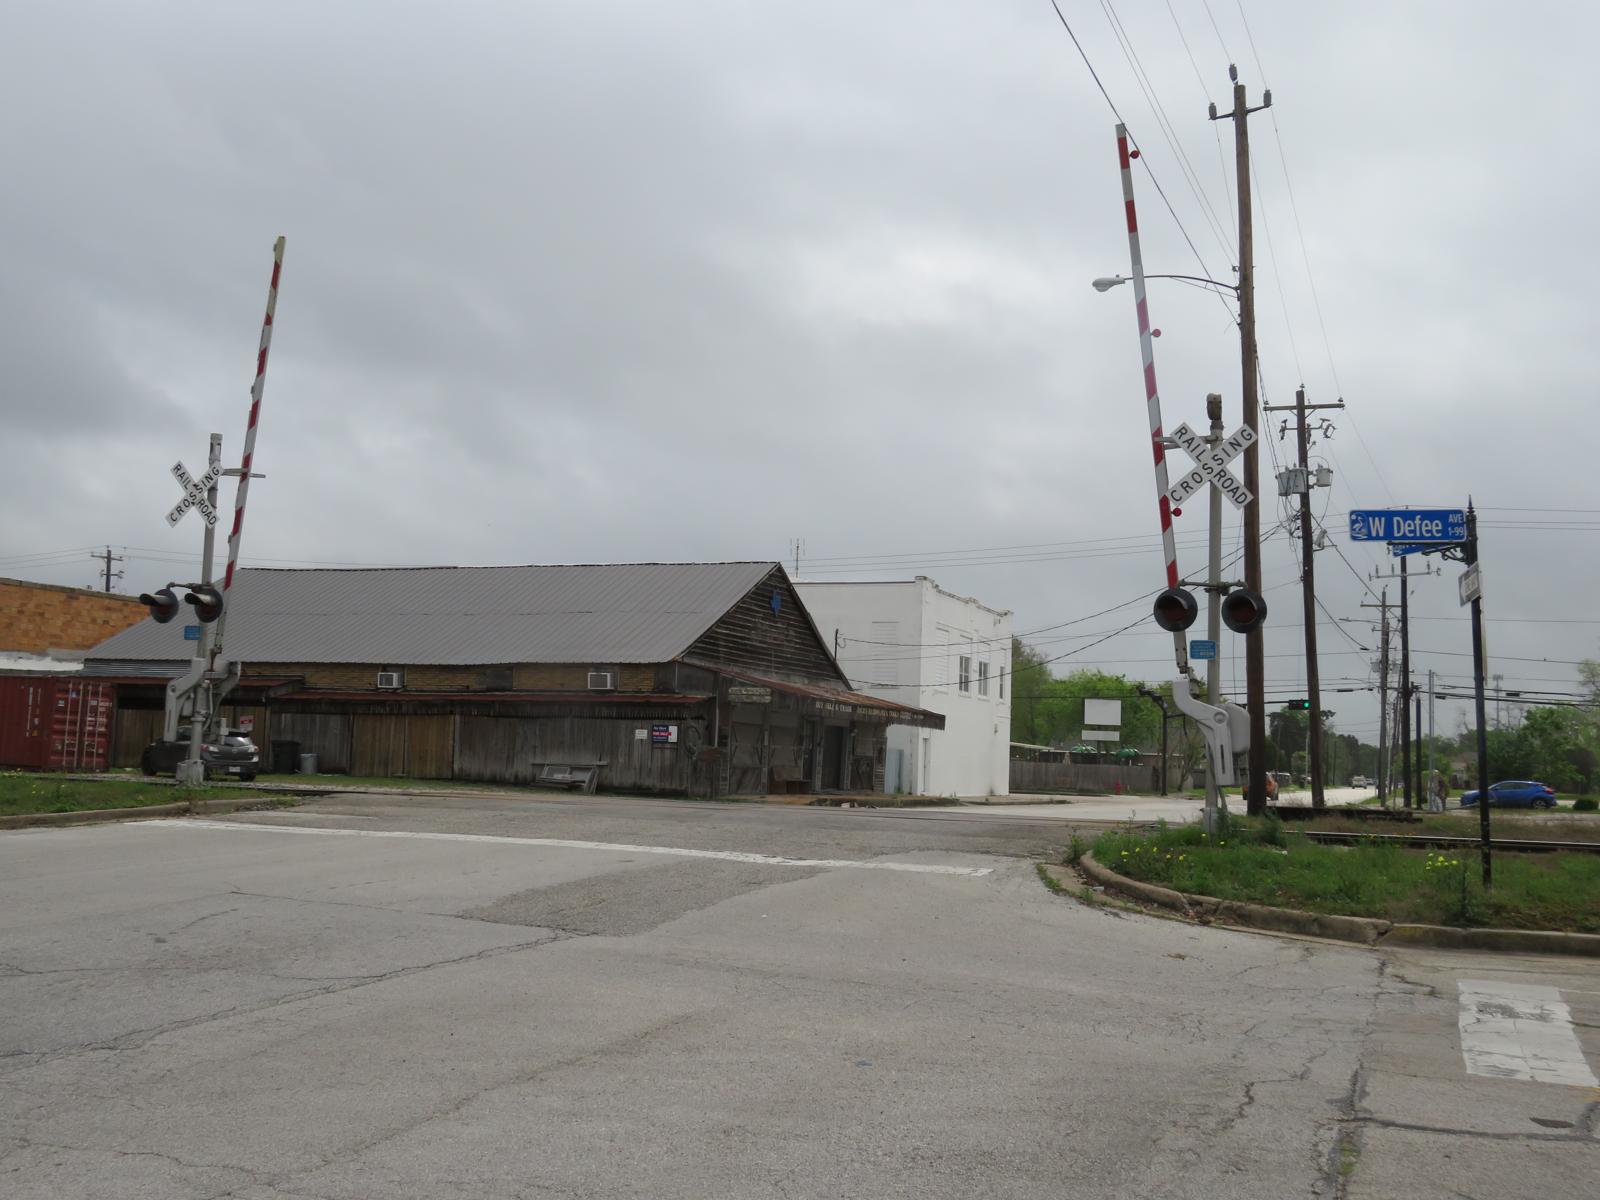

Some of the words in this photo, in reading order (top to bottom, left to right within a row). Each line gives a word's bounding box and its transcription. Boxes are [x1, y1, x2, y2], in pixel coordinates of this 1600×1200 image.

[1170, 428, 1253, 502] CROSSING
[170, 466, 220, 522] CROSSING
[1368, 516, 1385, 537] W
[1393, 515, 1442, 537] Defee
[1448, 513, 1463, 524] AVE
[1448, 526, 1464, 537] 1-99
